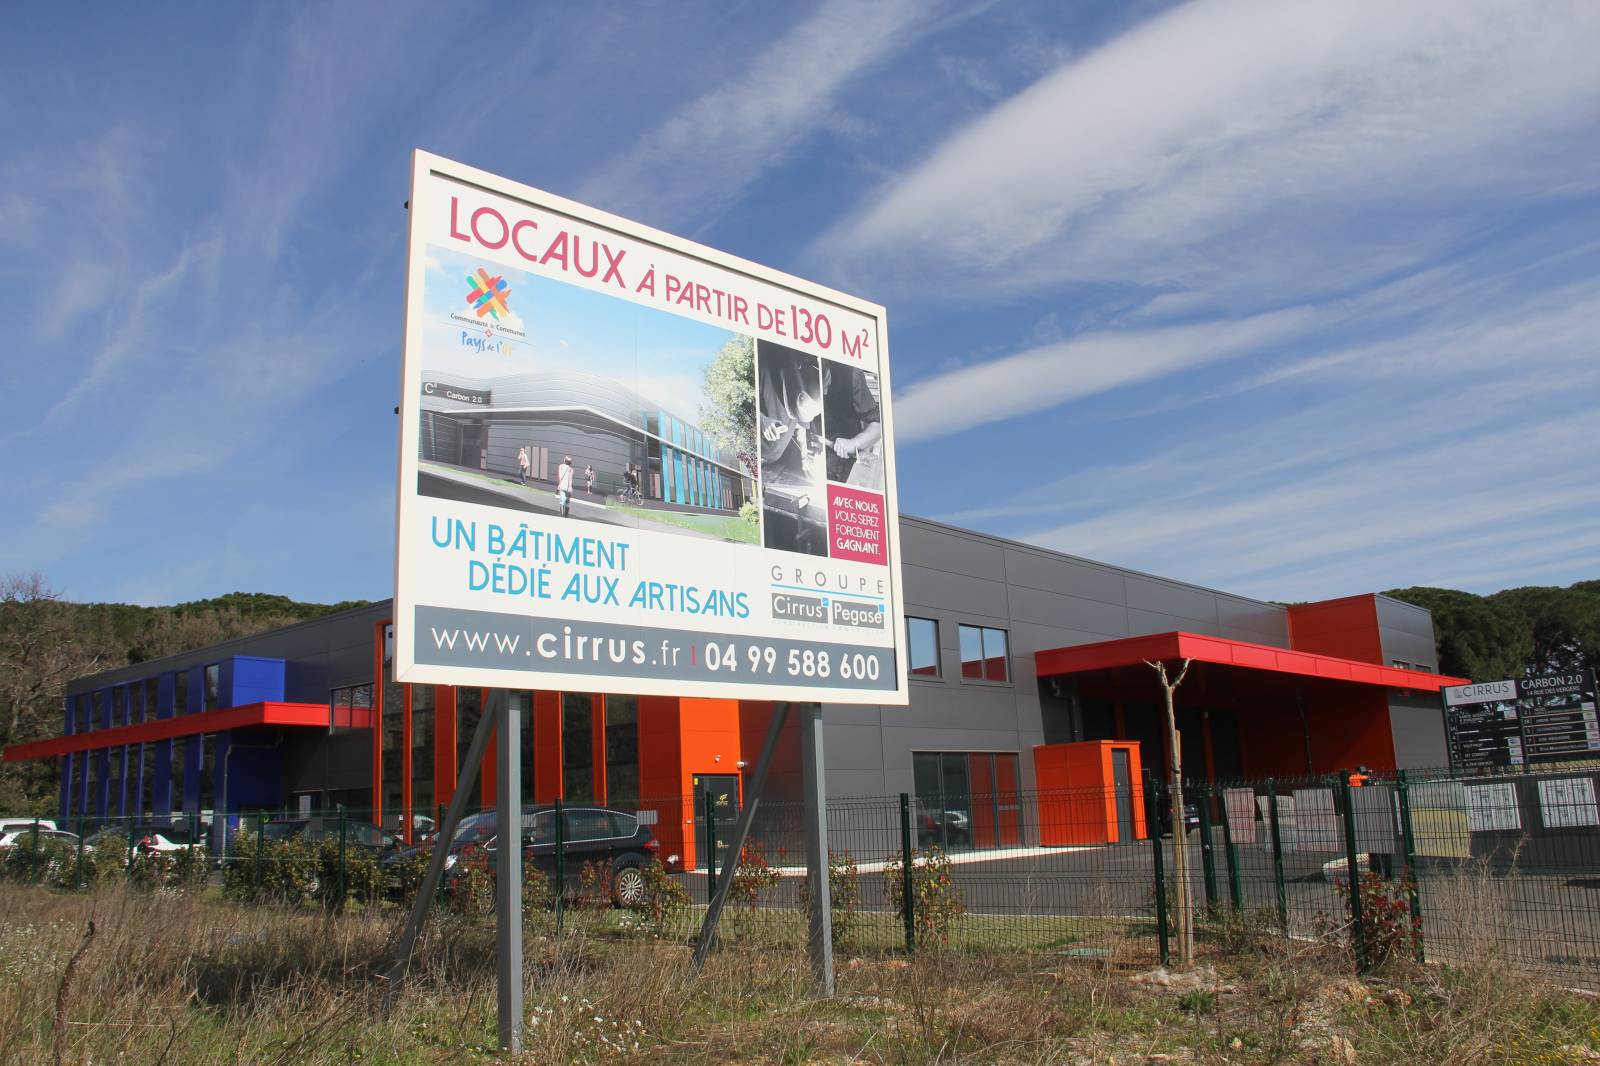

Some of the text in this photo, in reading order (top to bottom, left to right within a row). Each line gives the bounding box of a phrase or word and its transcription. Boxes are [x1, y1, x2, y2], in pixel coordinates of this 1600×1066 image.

[449, 196, 626, 288] LOCAUX
[635, 264, 656, 297] À
[665, 274, 750, 326] PARTIR
[757, 303, 787, 336] DE
[790, 304, 832, 349] 130
[461, 330, 486, 354] Pays
[446, 391, 470, 402] Carbon
[833, 496, 854, 509] AVEC
[835, 510, 879, 528] VOUS SEREZ
[431, 516, 630, 571] UN BÂTIMENT
[468, 557, 750, 619] DÉDIÉ AUX ARTISANS
[771, 565, 884, 594] GROUPE
[773, 595, 823, 618] Cirrus
[833, 602, 882, 625] Pegase
[431, 626, 880, 681] www.cirrus.fr 04 99 588 600
[1462, 682, 1510, 697] CIRRUS
[1521, 674, 1583, 690] CARBON 2.0
